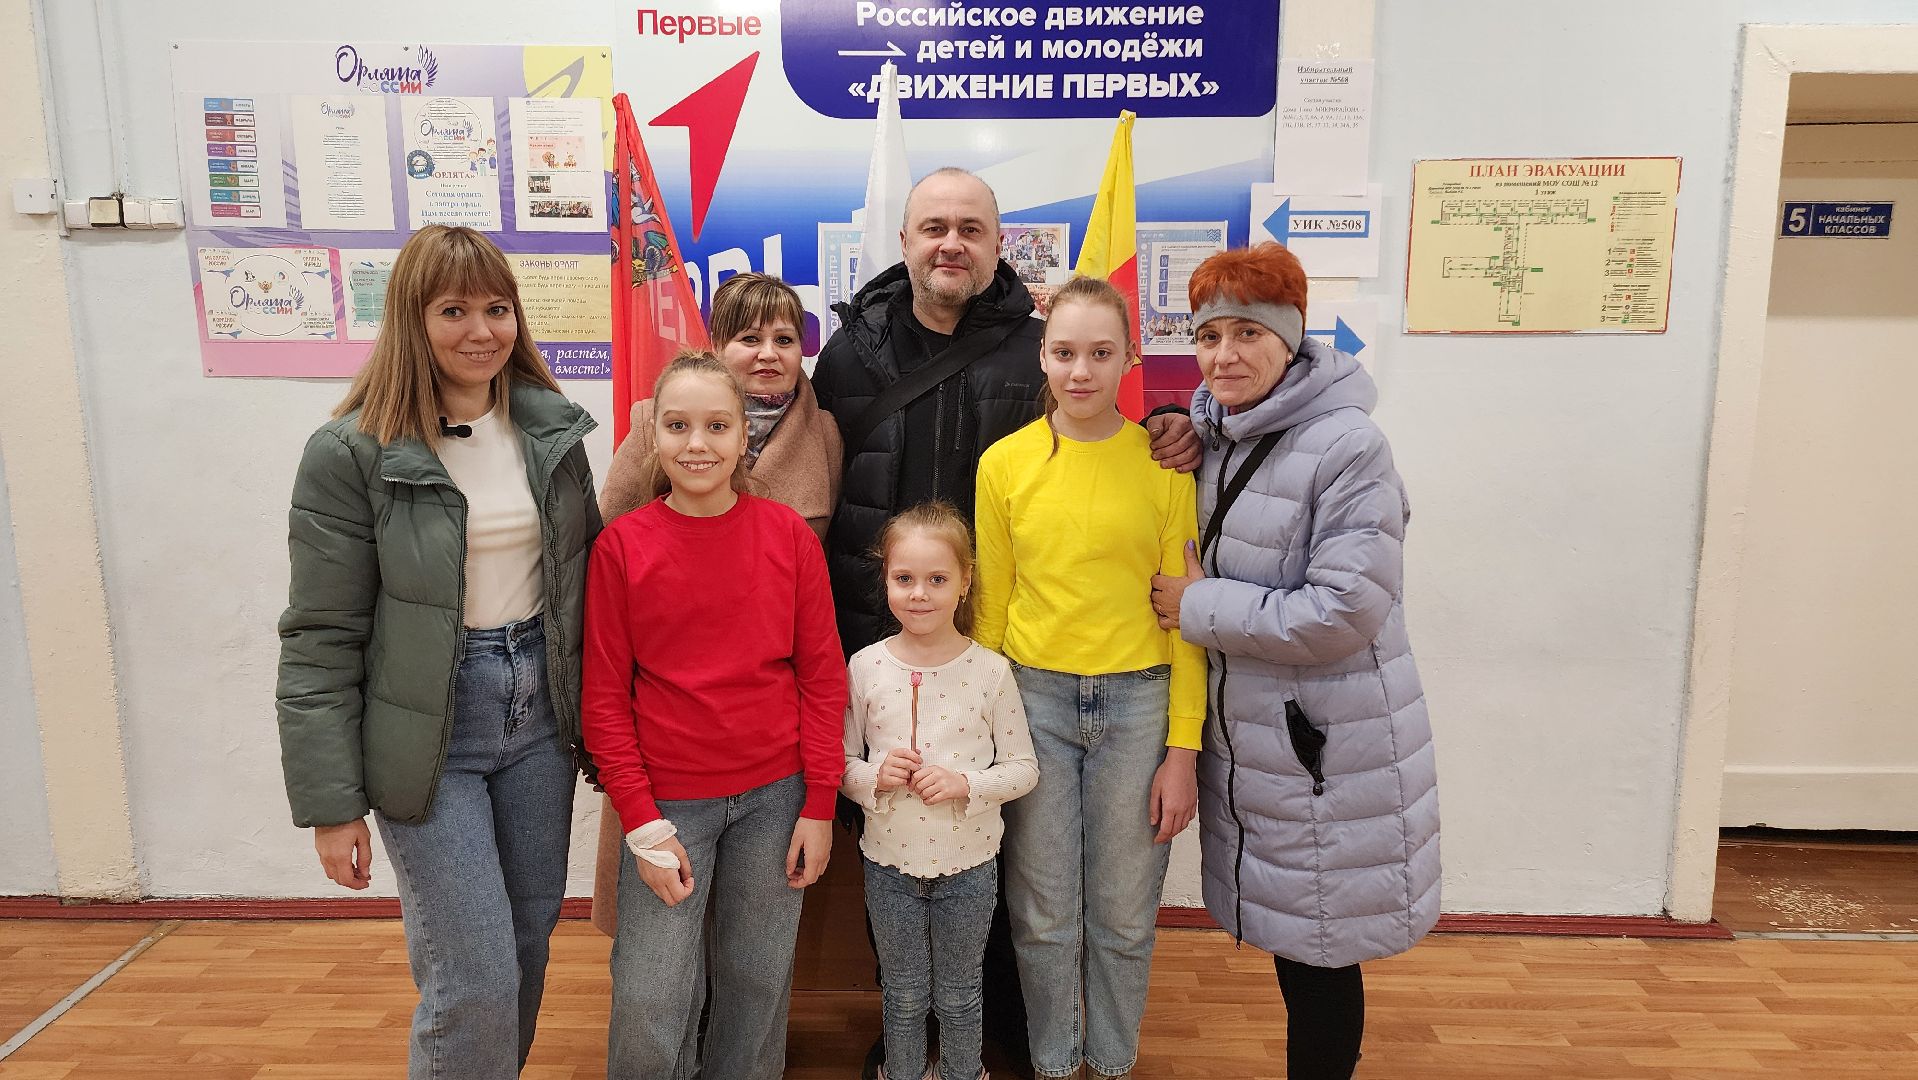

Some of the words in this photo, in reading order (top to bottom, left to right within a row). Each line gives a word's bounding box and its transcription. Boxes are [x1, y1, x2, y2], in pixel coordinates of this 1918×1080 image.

[856, 1, 1037, 27] Российское
[1044, 5, 1205, 31] движение
[637, 9, 762, 44] Первые
[916, 34, 1005, 64] детей
[1015, 39, 1032, 59] и
[1042, 31, 1203, 62] молодёжи
[335, 44, 421, 87] Орлята
[1297, 66, 1353, 74] Избирательный
[1062, 72, 1220, 99] ПЕРВЫХ»
[1468, 164, 1519, 178] ПЛАН
[1522, 164, 1627, 178] ЭВАКУАЦИИ
[1835, 205, 1872, 213] кабинет
[1292, 219, 1324, 230] УИК
[1326, 219, 1362, 230] №508
[1788, 207, 1807, 233] 5
[1818, 215, 1886, 224] НАЧАЛЬНЫХ
[1824, 225, 1878, 234] КЛАССОВ
[519, 260, 553, 269] ЗАКОНЫ
[554, 260, 579, 269] ОРЛЯТ
[229, 285, 292, 310] Орлята
[555, 347, 610, 364] растём,
[555, 362, 611, 376] вместе!»
